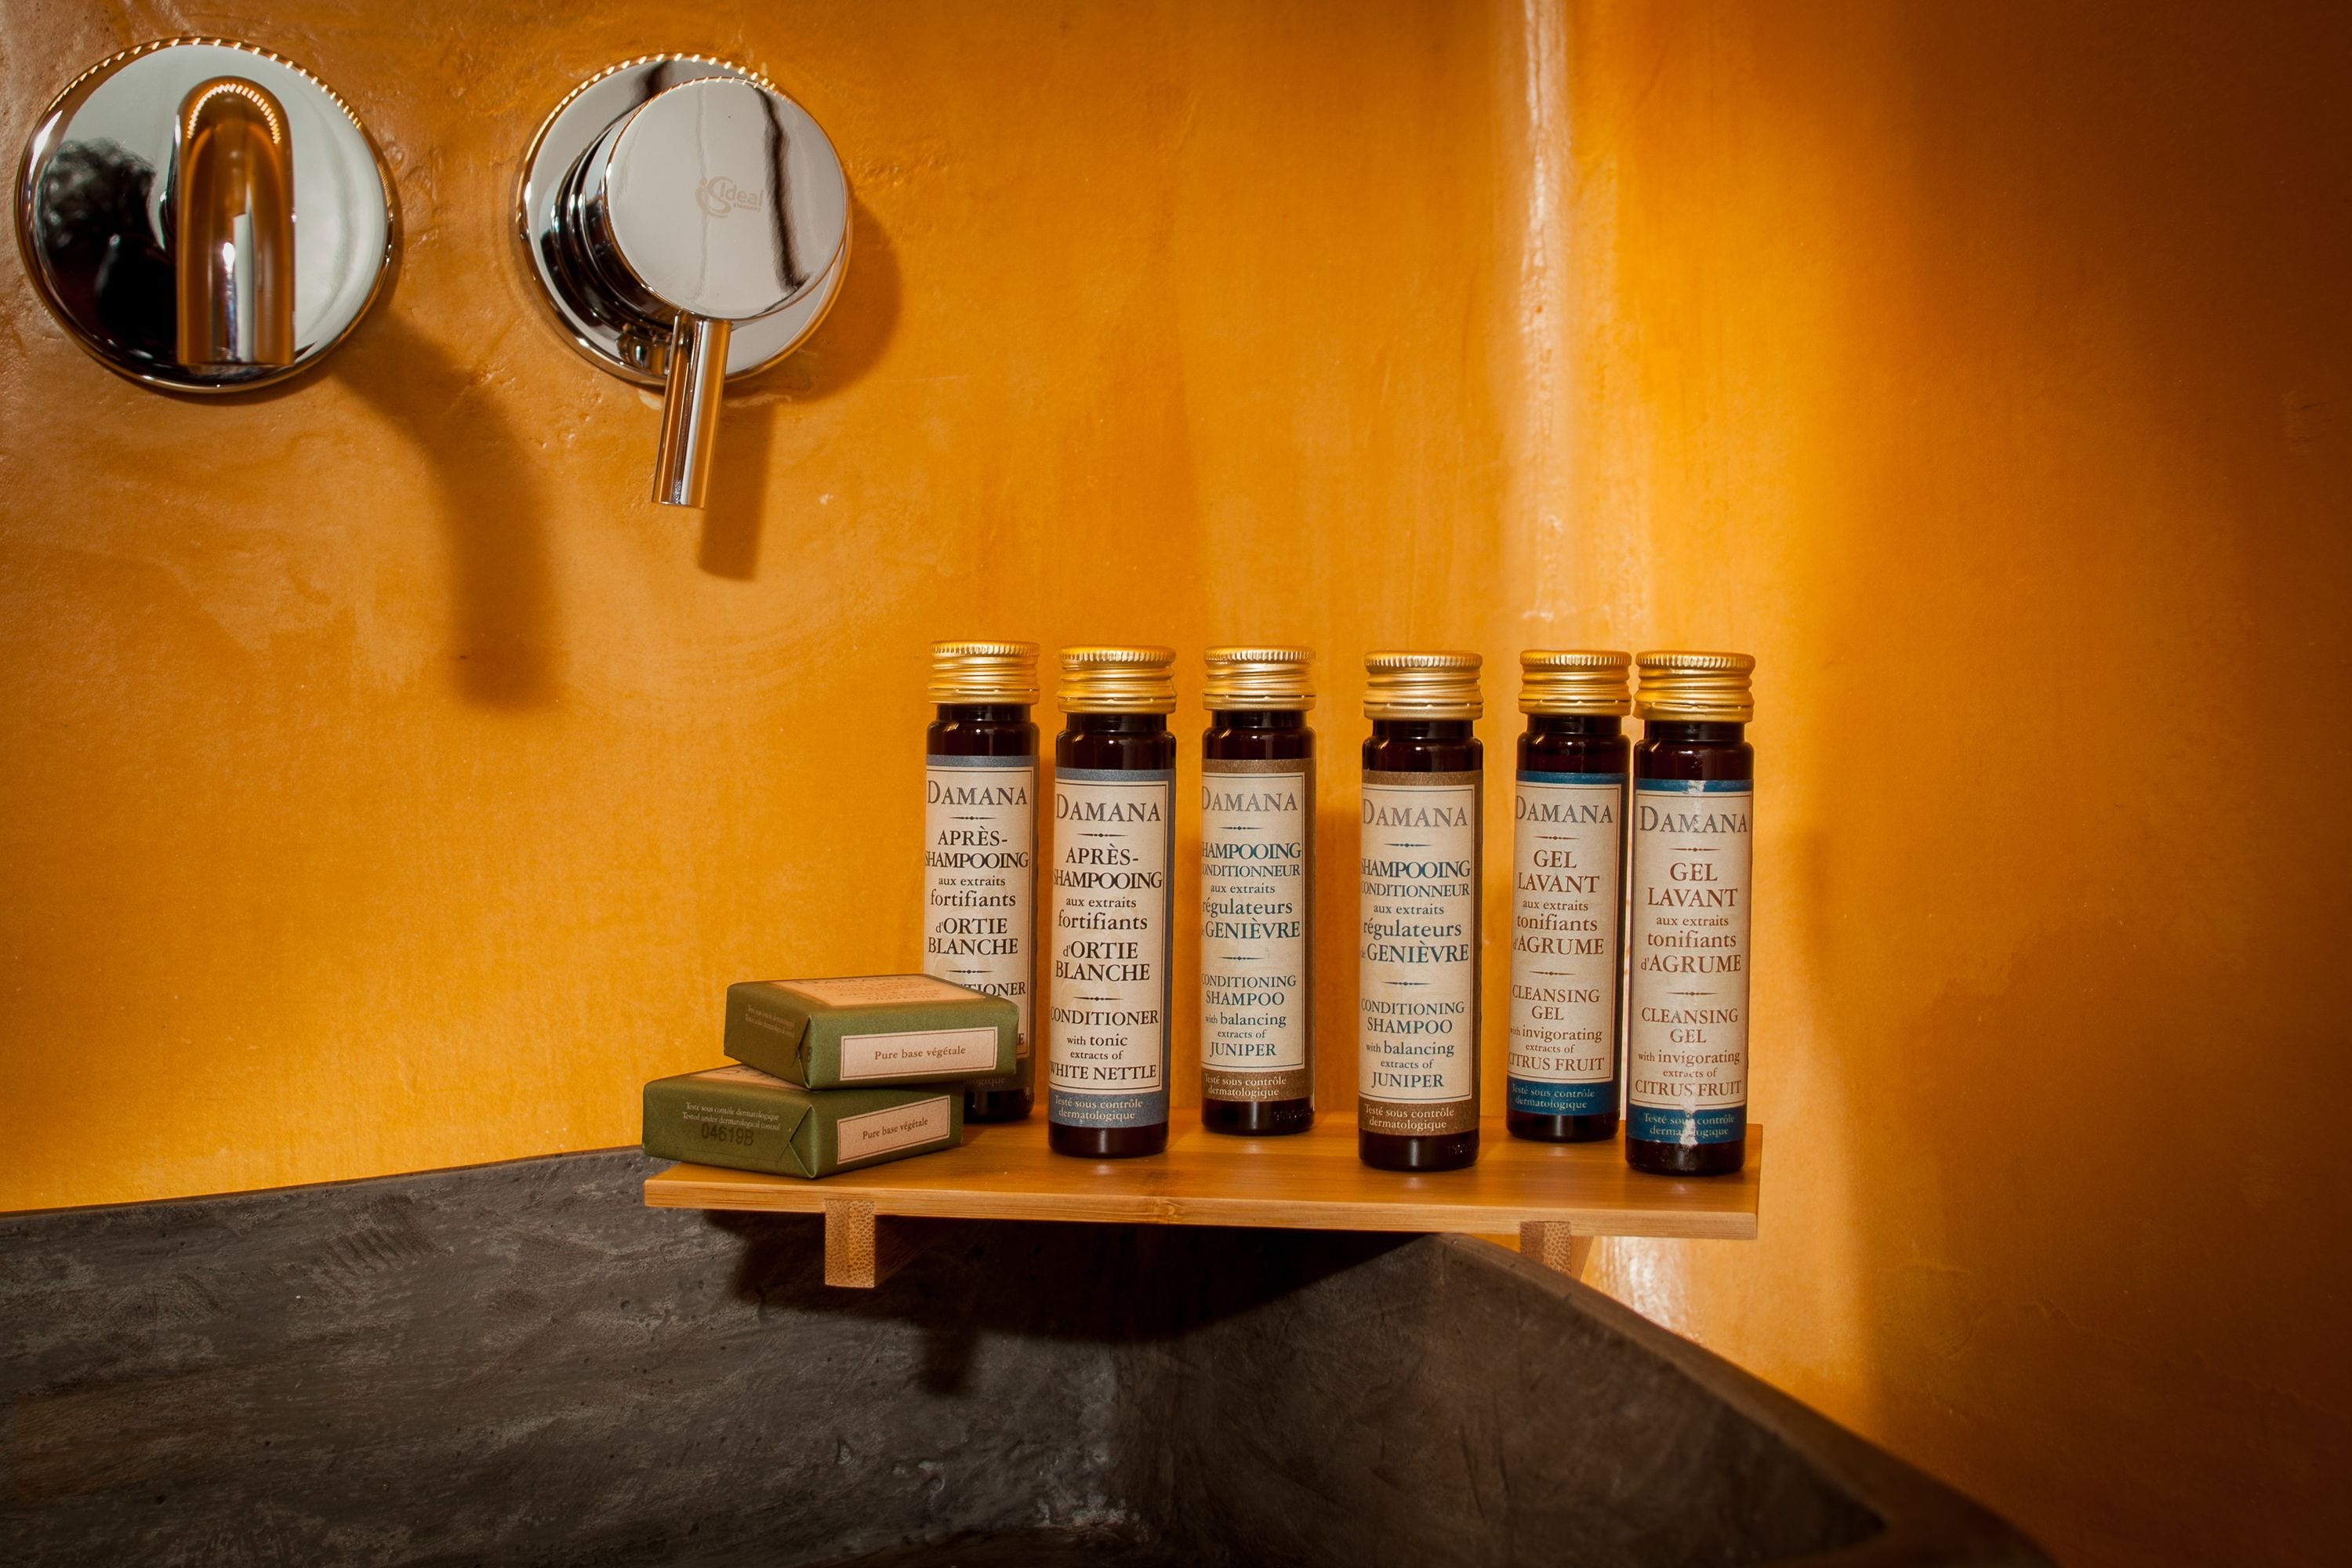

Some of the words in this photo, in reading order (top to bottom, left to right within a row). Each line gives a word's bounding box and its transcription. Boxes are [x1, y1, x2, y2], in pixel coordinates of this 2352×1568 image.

[720, 181, 764, 208] Ideal
[938, 826, 1007, 846] APRÈS-
[1065, 843, 1139, 866] APRÈS-
[1202, 841, 1301, 859] HAMPOOING
[1533, 849, 1577, 869] GEL
[1202, 863, 1301, 877] ONDITIONNEUR
[1669, 862, 1718, 881] GEL
[938, 877, 956, 886] aux
[960, 875, 1006, 886] extraits
[1210, 884, 1226, 893] aux
[1230, 883, 1276, 894] extraits
[1518, 872, 1600, 894] LAVANT
[931, 888, 1016, 907] fortifiants
[1361, 881, 1470, 898] CONDITIONNEUR
[1647, 887, 1737, 907] LAVANT
[1066, 897, 1084, 907] aux
[1088, 896, 1137, 908] extraits
[1203, 897, 1292, 917] régulateurs
[1374, 904, 1392, 914] aux
[1396, 903, 1444, 915] extraits
[1523, 899, 1540, 909] aux
[1543, 900, 1588, 912] extraits
[935, 917, 1007, 934] d'ORTIE
[1058, 909, 1148, 930] fortifiants
[1205, 917, 1301, 938] GENIÈVRE
[1517, 913, 1598, 931] tonifiants
[1656, 916, 1678, 926] aux
[1682, 915, 1729, 927] extraits
[1363, 917, 1461, 940] régulateurs
[928, 937, 1018, 955] BLANCHE
[1513, 935, 1604, 955] d'AGRUME
[1648, 930, 1737, 949] tonifiants
[1063, 941, 1138, 959] d'ORTIE
[1367, 940, 1469, 963] GENIÈVRE
[1055, 960, 1150, 982] BLANCHE
[1641, 953, 1741, 974] d'AGRUME
[1202, 973, 1296, 988] CONDITIONING
[1206, 990, 1284, 1006] SHAMPOO
[1512, 984, 1600, 1004] CLEANSING
[1361, 998, 1465, 1015] CONDITIONING
[1531, 1005, 1564, 1020] GEL
[1051, 1006, 1159, 1025] CONDITIONER
[1205, 1014, 1218, 1024] with
[1220, 1011, 1287, 1028] balancing
[1642, 1007, 1739, 1024] CLEANSING
[1367, 1016, 1453, 1034] SHAMPOO
[1510, 1025, 1521, 1036] with
[1523, 1024, 1602, 1043] invigorating
[1067, 1035, 1086, 1045] with
[1090, 1033, 1127, 1047] tonic
[1217, 1030, 1252, 1039] extracts
[1255, 1029, 1266, 1039] of
[1670, 1029, 1707, 1044] GEL
[874, 1051, 898, 1060] Pure
[902, 1049, 923, 1058] base
[927, 1045, 966, 1058] végétale
[1070, 1051, 1109, 1060] extracts
[1112, 1050, 1123, 1060] of
[1210, 1041, 1277, 1058] JUNIPER
[1366, 1042, 1381, 1053] with
[1384, 1040, 1454, 1057] balancing
[1526, 1044, 1560, 1053] extracts
[1564, 1044, 1575, 1053] of
[1381, 1060, 1418, 1069] extracts
[1422, 1058, 1434, 1069] of
[1508, 1051, 1550, 1071] CITRUS
[1555, 1058, 1604, 1072] FRUIT
[1638, 1051, 1655, 1062] with
[1658, 1049, 1740, 1067] invigorating
[1050, 1061, 1088, 1080] WHITE
[1092, 1065, 1156, 1080] NETTLE
[1663, 1069, 1704, 1078] extracts
[1707, 1068, 1718, 1078] of
[1204, 1073, 1220, 1083] Testé
[1222, 1076, 1242, 1086] sous
[1245, 1076, 1287, 1087] contrôle
[1371, 1071, 1444, 1088] JUNIPER
[1635, 1079, 1693, 1097] CITRUS
[1698, 1080, 1742, 1096] FRUIT
[1208, 1085, 1279, 1099] dermatologique
[1512, 1083, 1528, 1094] Testé
[1530, 1088, 1551, 1097] sous
[1554, 1087, 1595, 1098] contrôle
[1054, 1094, 1073, 1105] Testé
[1075, 1099, 1096, 1109] sous
[1100, 1098, 1143, 1109] contrôle
[1515, 1095, 1588, 1111] dermatologique
[1058, 1107, 1135, 1122] dermatologique
[1365, 1103, 1383, 1116] Testé
[1386, 1109, 1408, 1118] sous
[1411, 1107, 1454, 1119] contrôle
[1643, 1112, 1666, 1123] Testé
[1697, 1112, 1735, 1125] contrôle
[862, 1130, 880, 1140] Pure
[882, 1126, 898, 1135] base
[900, 1117, 928, 1132] végétale
[1369, 1116, 1447, 1131] dermatologique
[1650, 1124, 1729, 1139] dermalogique
[701, 1122, 754, 1146] 04619B
